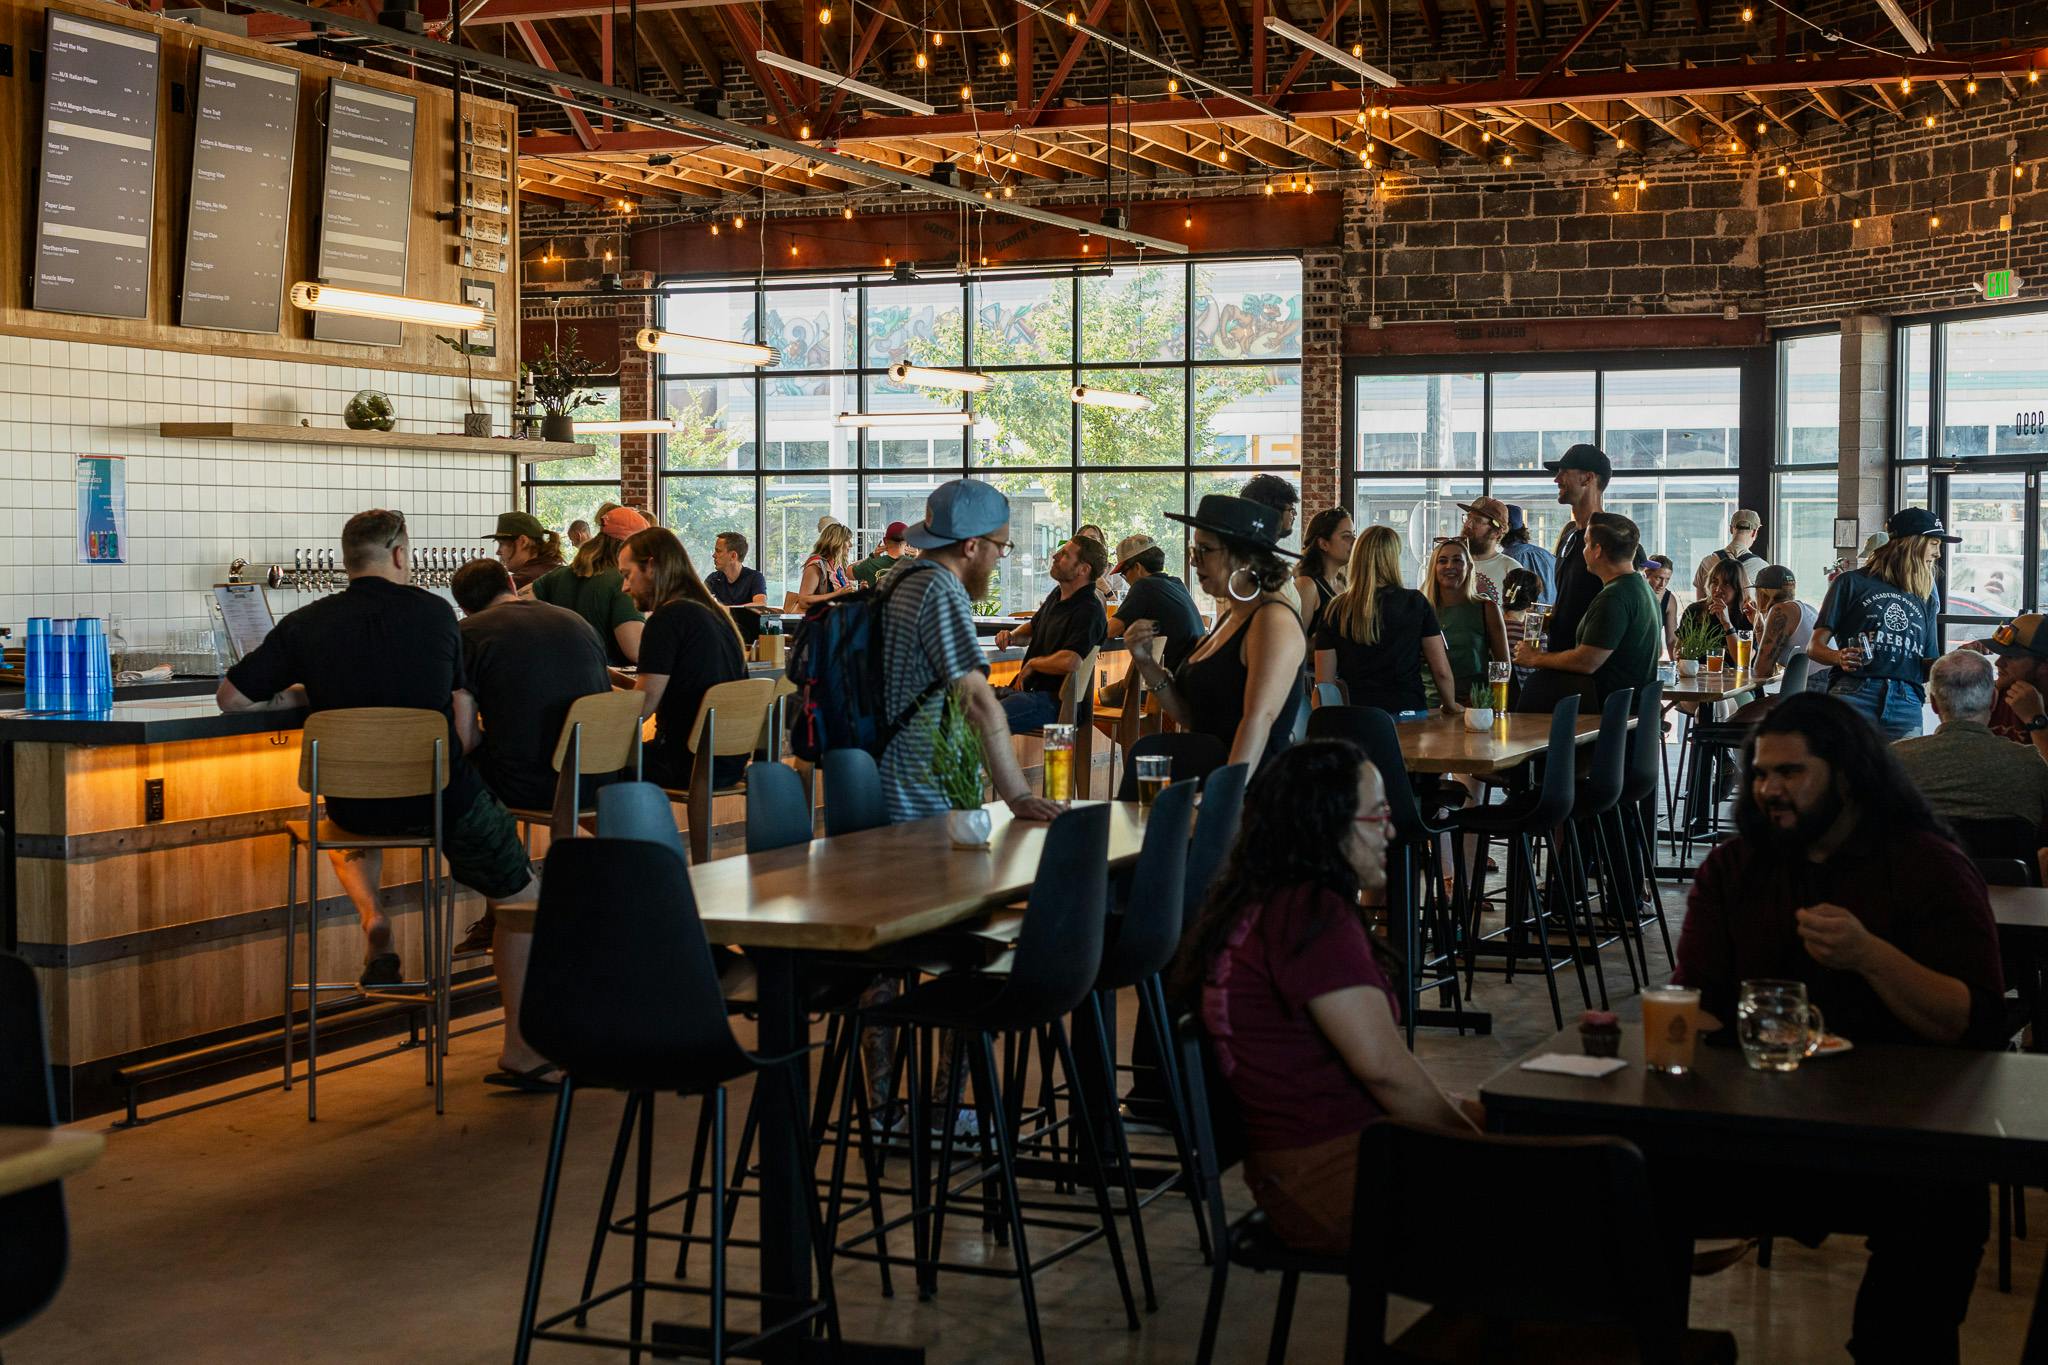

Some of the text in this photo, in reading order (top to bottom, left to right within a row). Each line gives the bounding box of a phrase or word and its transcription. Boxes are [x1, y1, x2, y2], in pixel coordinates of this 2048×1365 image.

[1988, 271, 2010, 297] EXIT
[1862, 598, 1872, 607] AN
[1872, 592, 1902, 601] ACADEMIC
